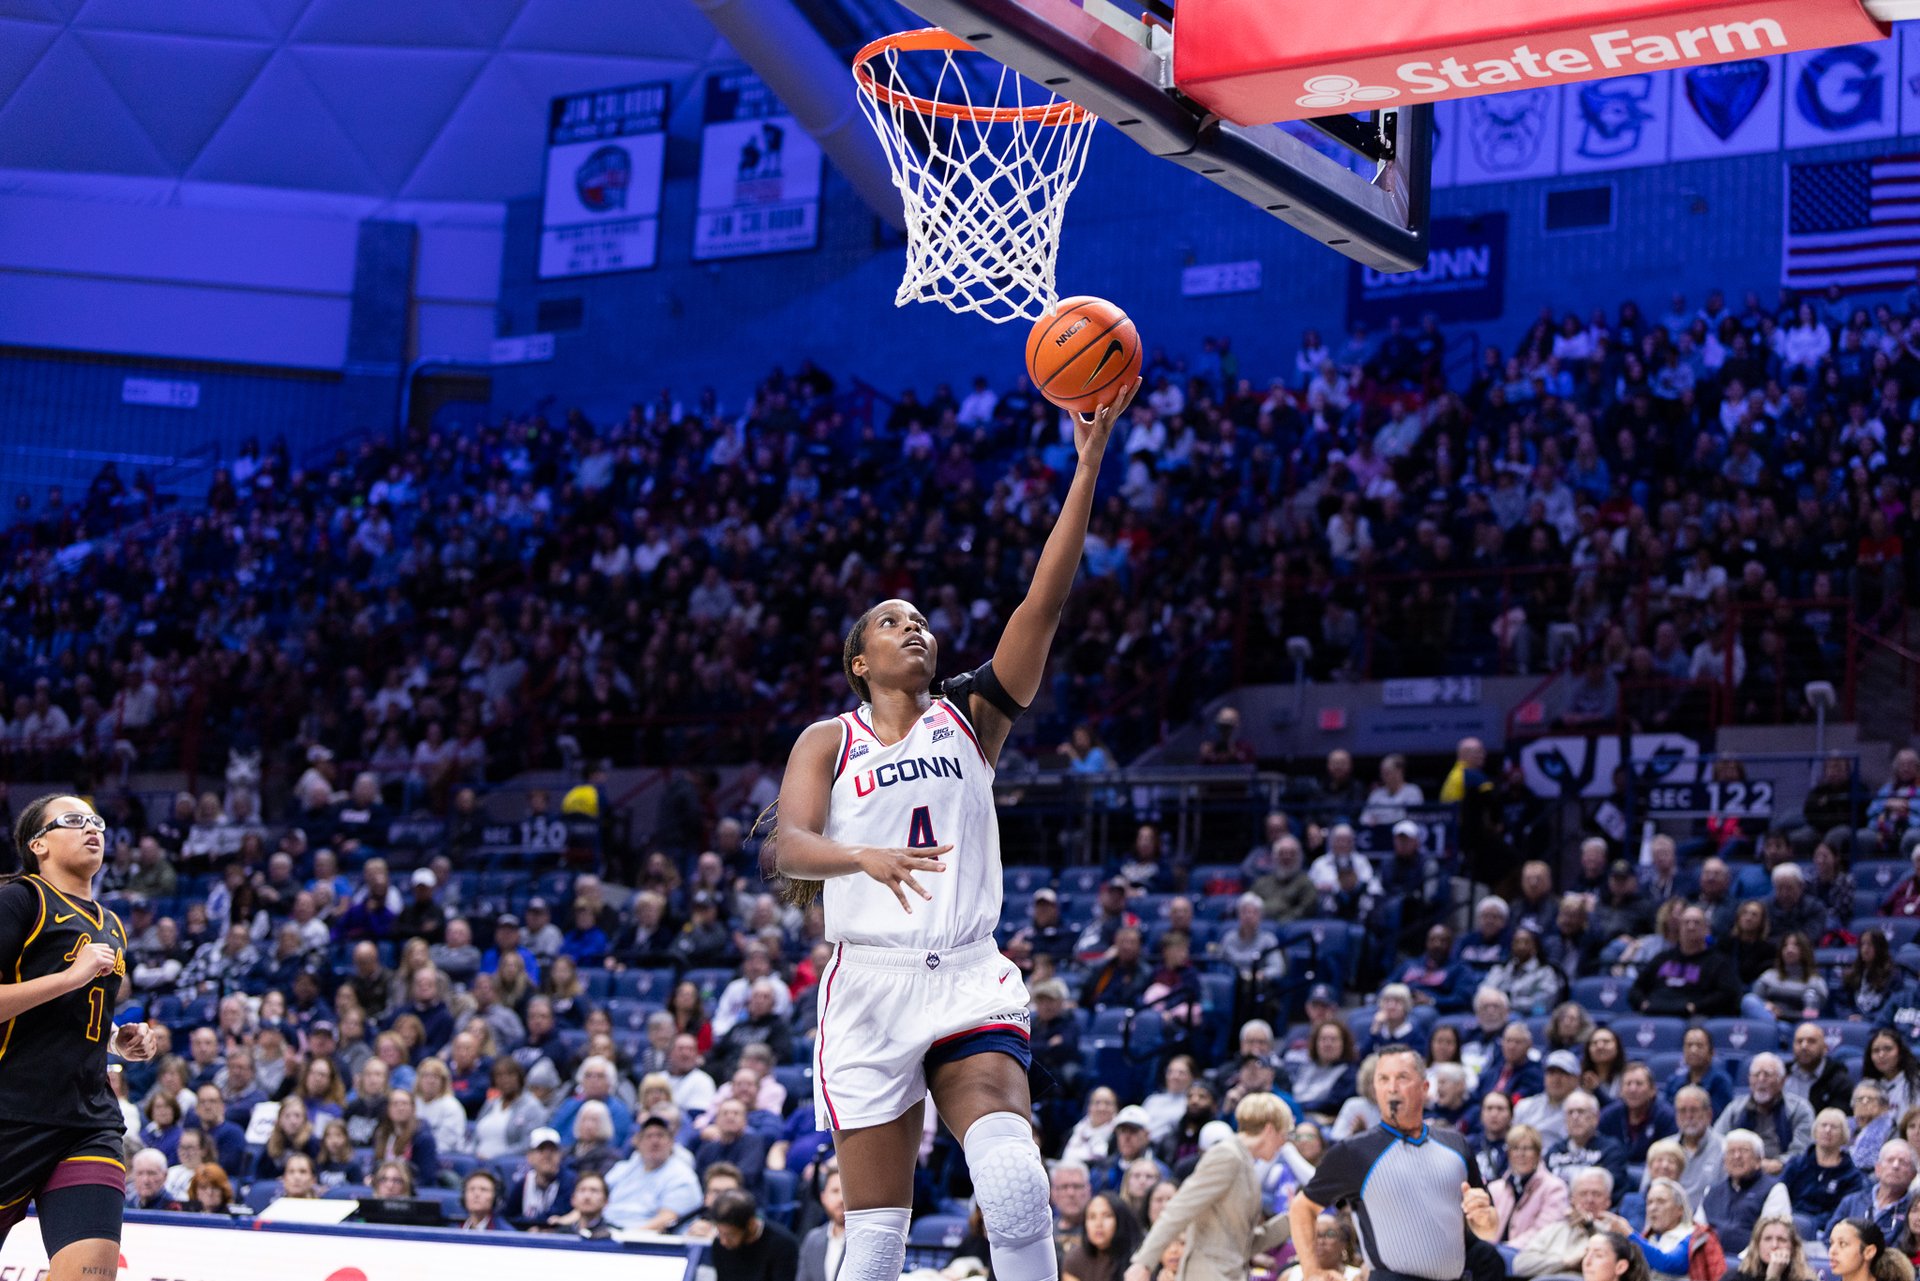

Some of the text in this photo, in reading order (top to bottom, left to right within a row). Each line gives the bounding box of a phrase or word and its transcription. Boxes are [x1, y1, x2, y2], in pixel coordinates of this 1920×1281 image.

[854, 756, 963, 798] UCONN
[1649, 781, 1773, 814] SEC 122
[520, 818, 568, 849] 120
[907, 805, 939, 862] 4
[86, 986, 105, 1042] 1
